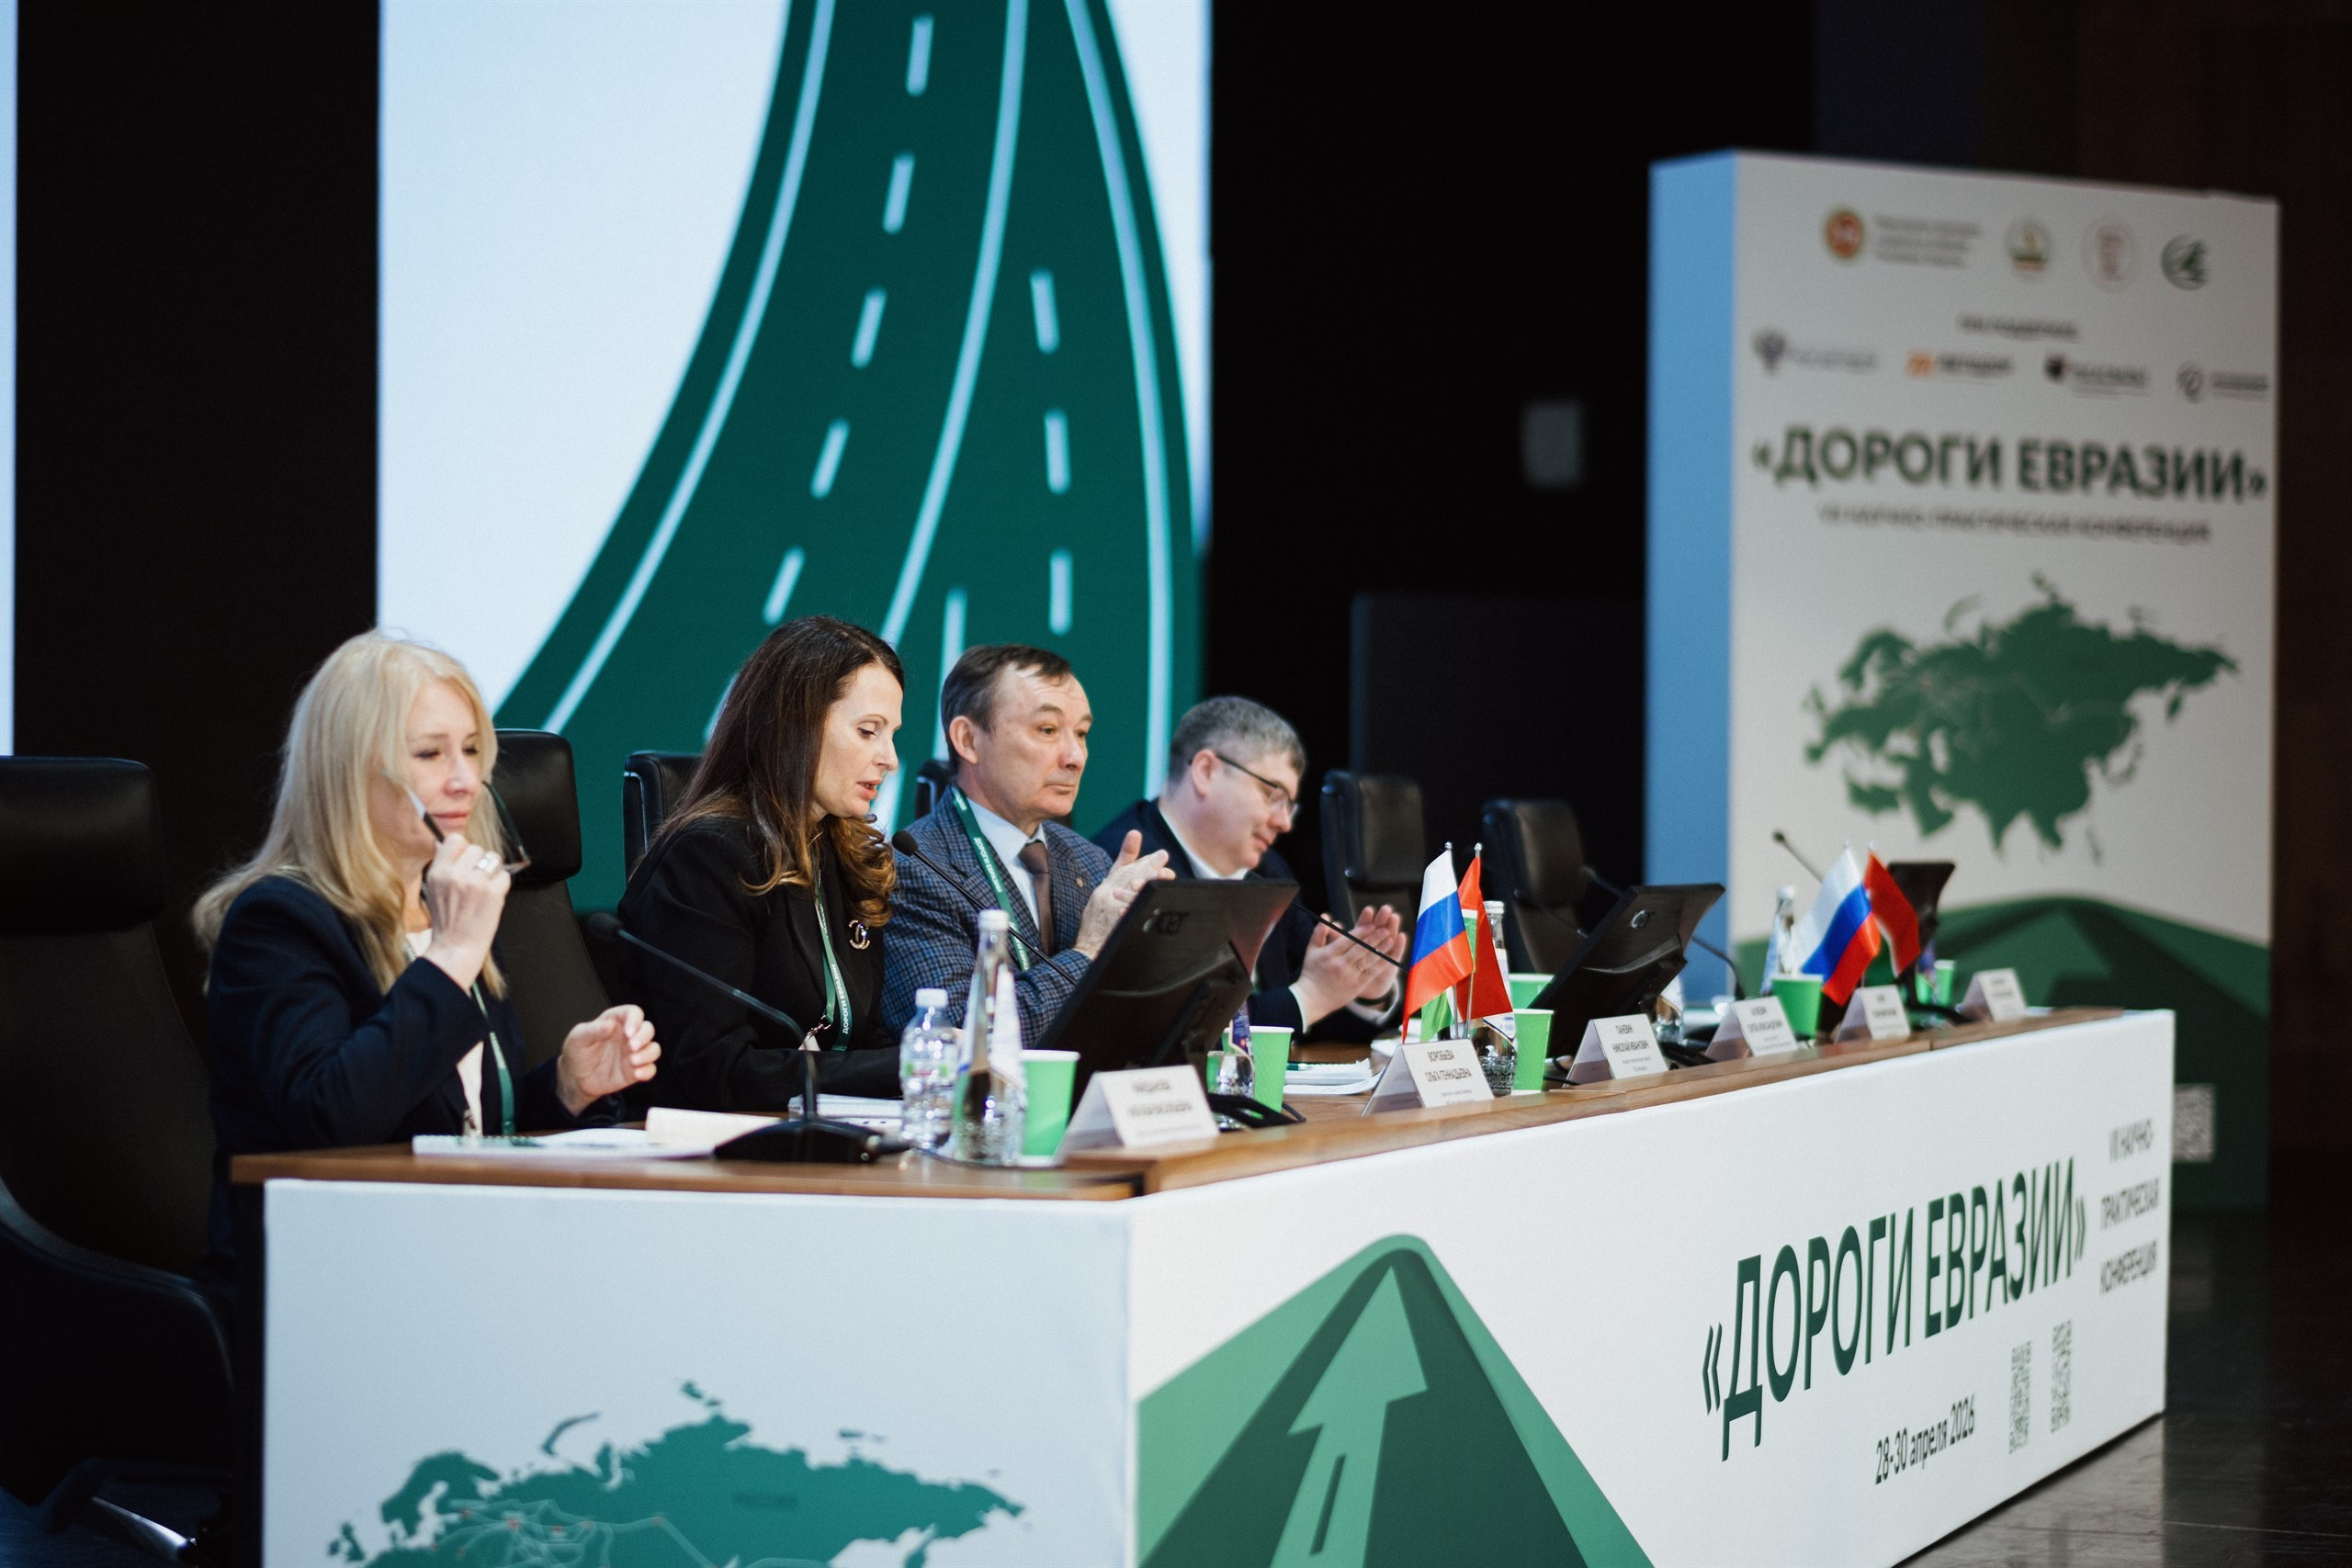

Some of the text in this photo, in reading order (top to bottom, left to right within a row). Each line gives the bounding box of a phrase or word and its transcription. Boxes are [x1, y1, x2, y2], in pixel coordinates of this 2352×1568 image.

[1753, 425, 2269, 503] «ДОРОГИ ЕВРАЗИИ»
[973, 837, 1001, 892] ДОРОГИ ЕВРАЗИИ
[831, 964, 850, 1035] ДОРОГИ ЕВРАЗИИ
[1702, 1156, 2087, 1462] «ДОРОГИ ЕВРАЗИИ»
[1875, 1393, 1974, 1484] 28-30 апреля 2026
